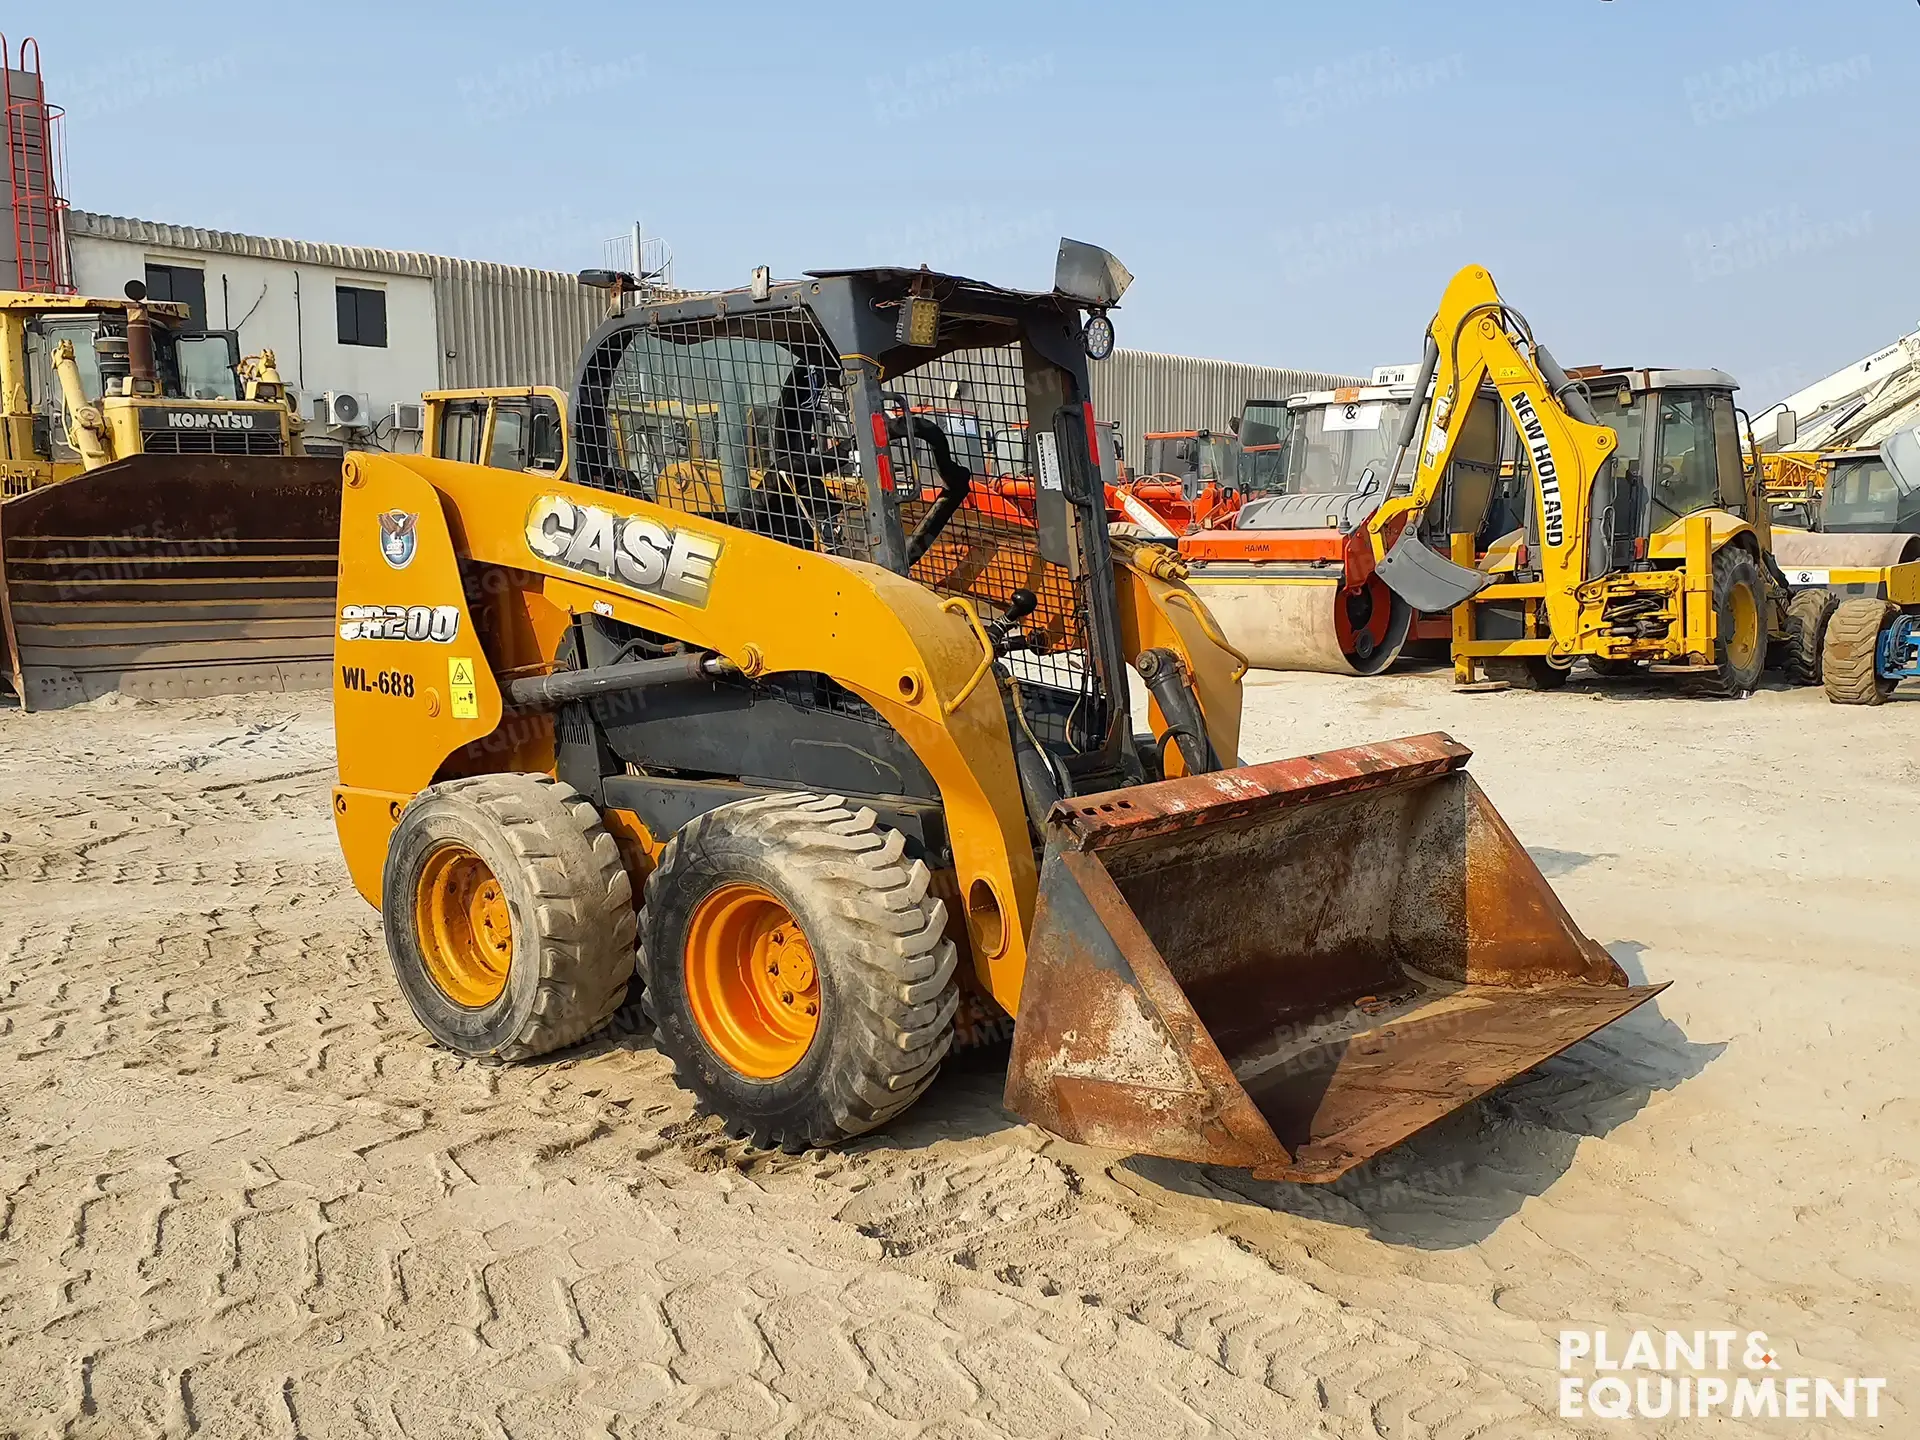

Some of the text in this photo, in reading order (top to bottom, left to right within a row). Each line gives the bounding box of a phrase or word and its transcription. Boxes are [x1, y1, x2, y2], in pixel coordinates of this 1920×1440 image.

[168, 411, 254, 429] KOMATSU
[1511, 391, 1563, 547] NEW HOLLAND
[525, 494, 722, 600] CASE
[1244, 544, 1270, 552] HAMM
[341, 665, 415, 699] WL-688
